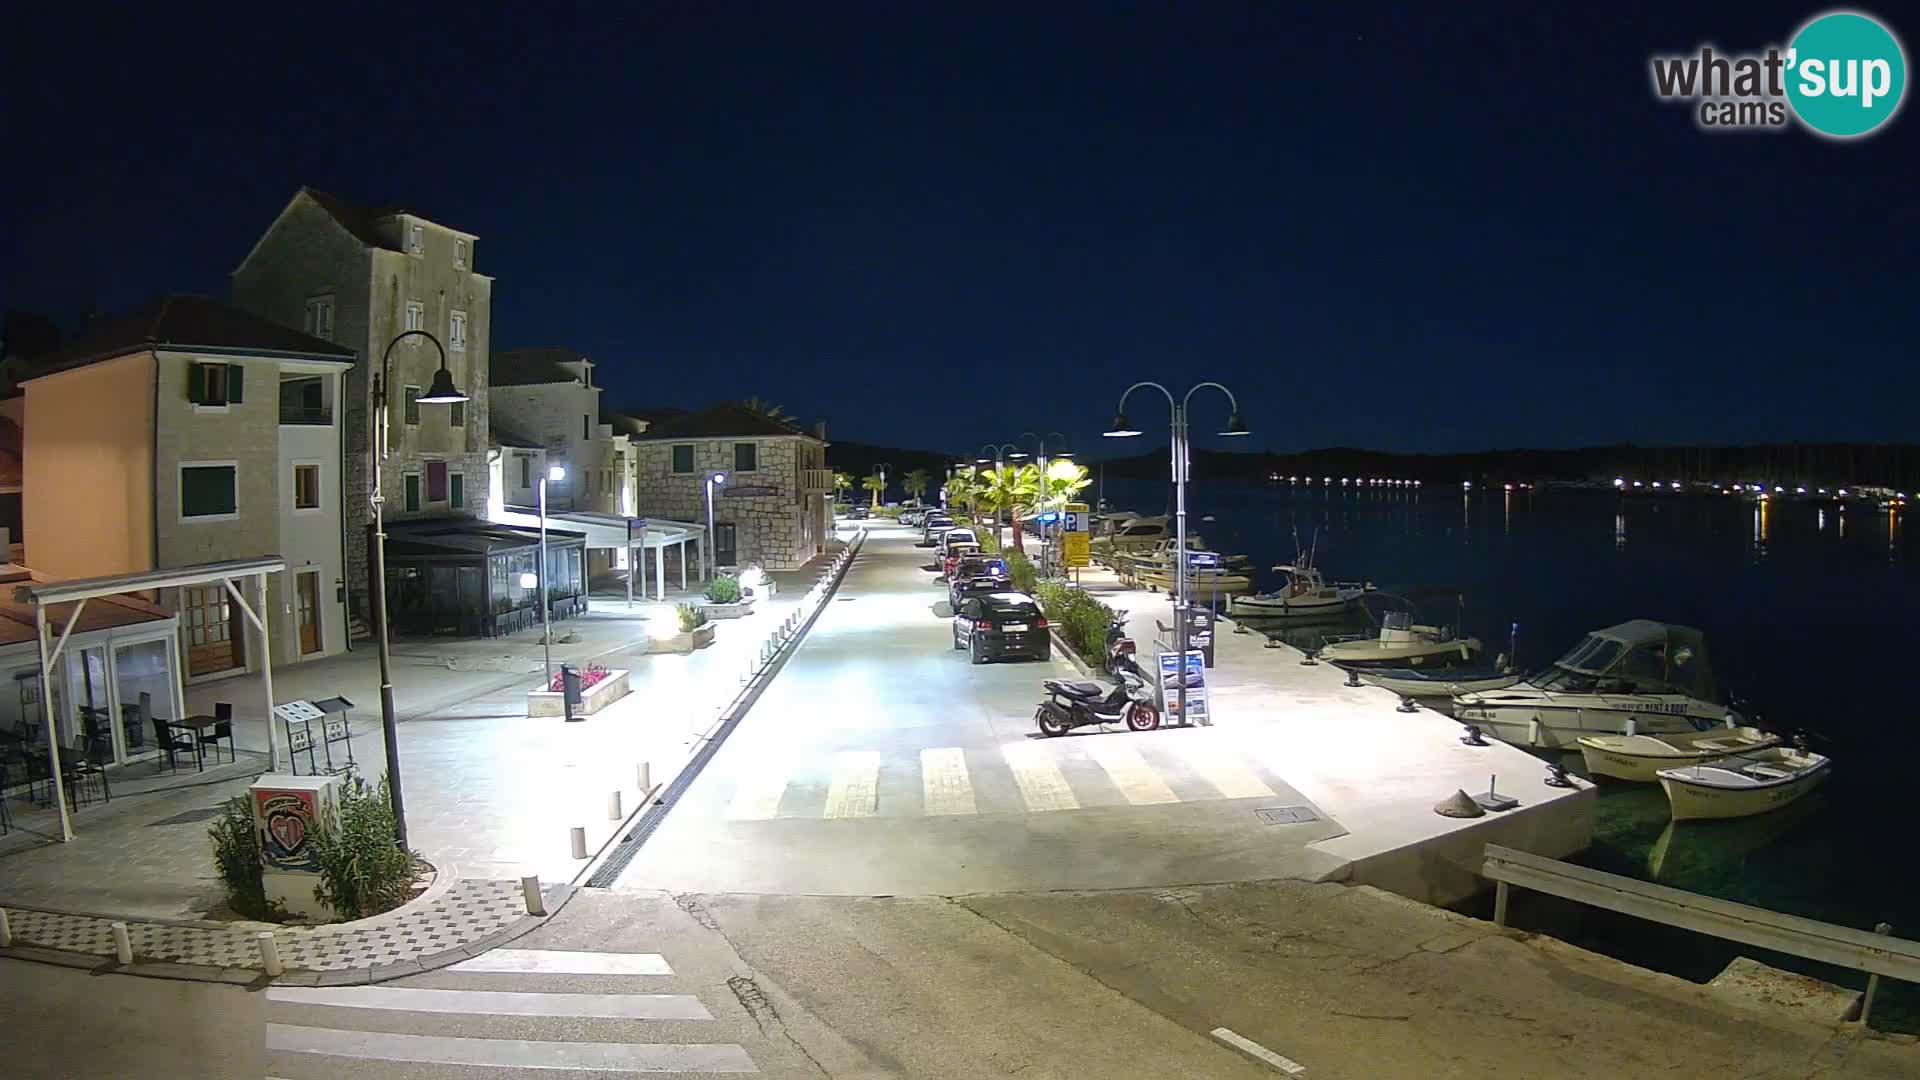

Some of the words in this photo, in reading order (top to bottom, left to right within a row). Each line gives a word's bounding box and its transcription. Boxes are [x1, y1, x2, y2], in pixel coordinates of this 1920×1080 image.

[1066, 514, 1076, 530] P
[1645, 703, 1663, 713] RENT
[1670, 703, 1688, 714] BOAT
